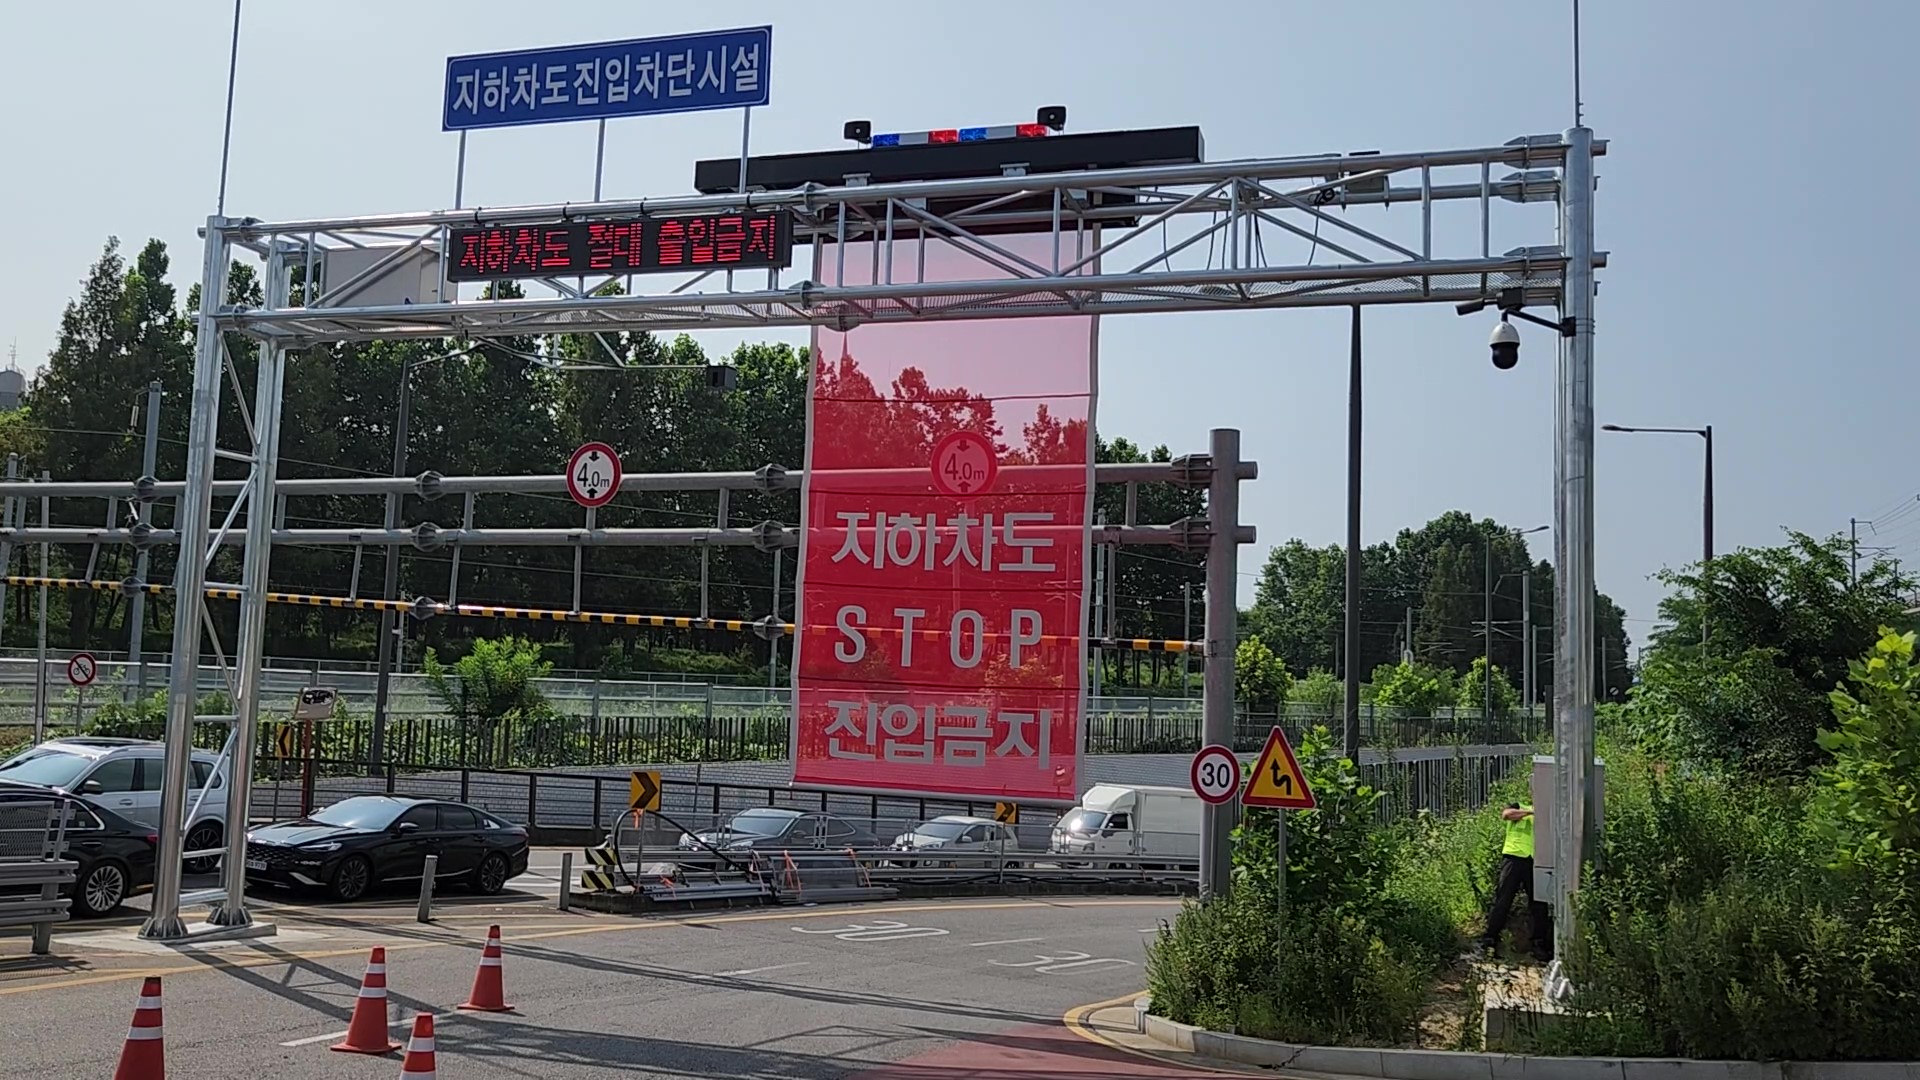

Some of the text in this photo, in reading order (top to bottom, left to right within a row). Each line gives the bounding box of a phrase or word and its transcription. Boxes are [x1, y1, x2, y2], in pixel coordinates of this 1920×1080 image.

[452, 44, 759, 115] 지하차도진입차단시설
[460, 215, 775, 273] 지하차도 절대 출입금지
[577, 462, 610, 488] 4.0m
[945, 453, 985, 481] 4.0m
[831, 511, 1056, 572] 지하차도
[824, 700, 1051, 770] 진입금지
[1202, 762, 1231, 788] 30
[791, 920, 950, 941] 30
[987, 950, 1137, 975] 30
